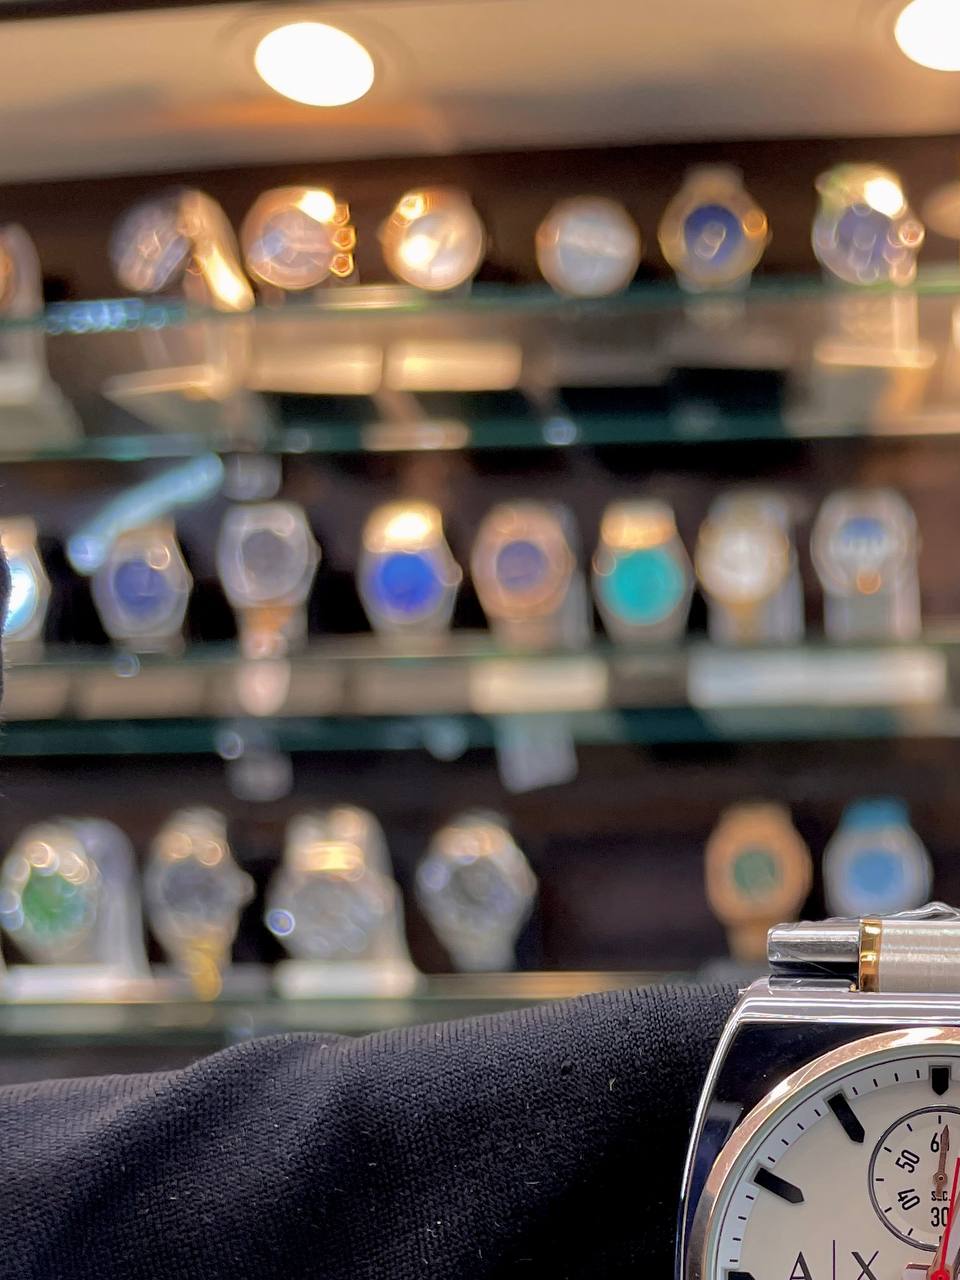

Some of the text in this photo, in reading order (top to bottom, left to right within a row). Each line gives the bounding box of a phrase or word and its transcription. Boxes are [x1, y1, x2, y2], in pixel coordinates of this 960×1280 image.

[930, 1132, 950, 1153] 6
[895, 1149, 920, 1173] 50
[897, 1188, 920, 1211] 40
